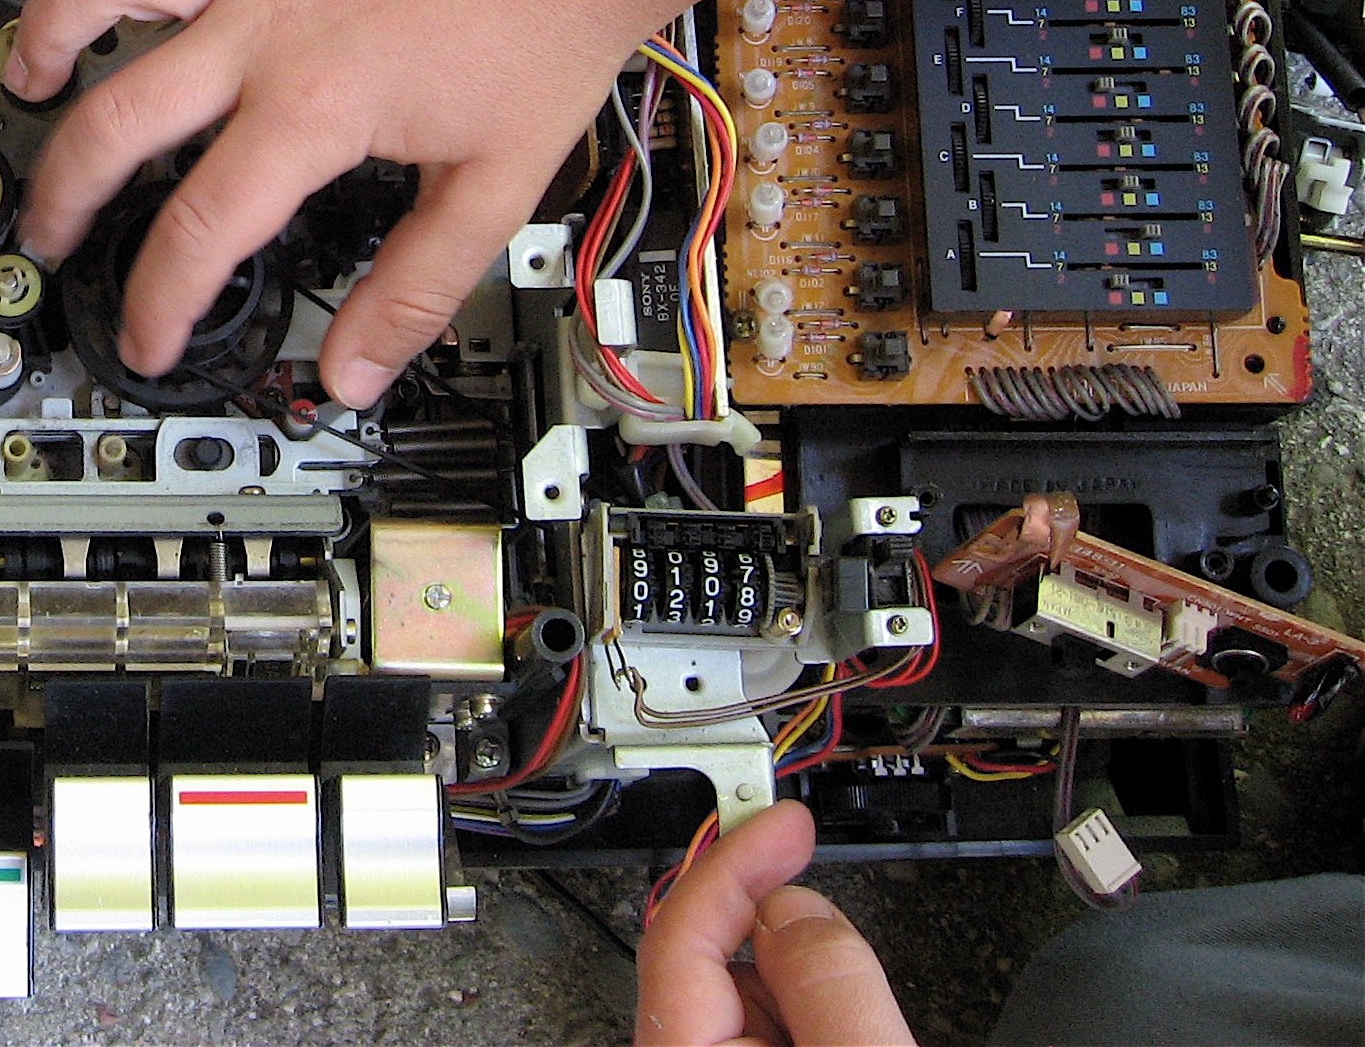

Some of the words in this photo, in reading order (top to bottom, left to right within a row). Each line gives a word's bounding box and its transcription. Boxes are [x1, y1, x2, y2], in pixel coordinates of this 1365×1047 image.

[956, 7, 965, 17] F
[1035, 7, 1048, 18] 14
[1038, 18, 1045, 28] 7
[1183, 17, 1196, 28] 13
[934, 54, 943, 65] E
[1038, 55, 1051, 66] 14
[1041, 66, 1049, 76] 7
[1187, 65, 1199, 76] 13
[961, 103, 971, 113] D
[1041, 104, 1055, 115] 14
[1045, 115, 1053, 125] 7
[1191, 115, 1204, 125] 13
[939, 151, 949, 162] C
[1045, 153, 1059, 163] 14
[1049, 164, 1057, 174] 7
[1195, 163, 1208, 174] 13
[968, 199, 978, 210] B
[1050, 201, 1063, 212] 14
[1052, 213, 1060, 223] 7
[1200, 212, 1213, 222] 13
[946, 249, 957, 260] A
[1052, 250, 1066, 260] 14
[1056, 262, 1064, 272] 7
[1203, 261, 1217, 272] 13
[641, 271, 653, 317] SONY
[654, 264, 670, 322] BX-342
